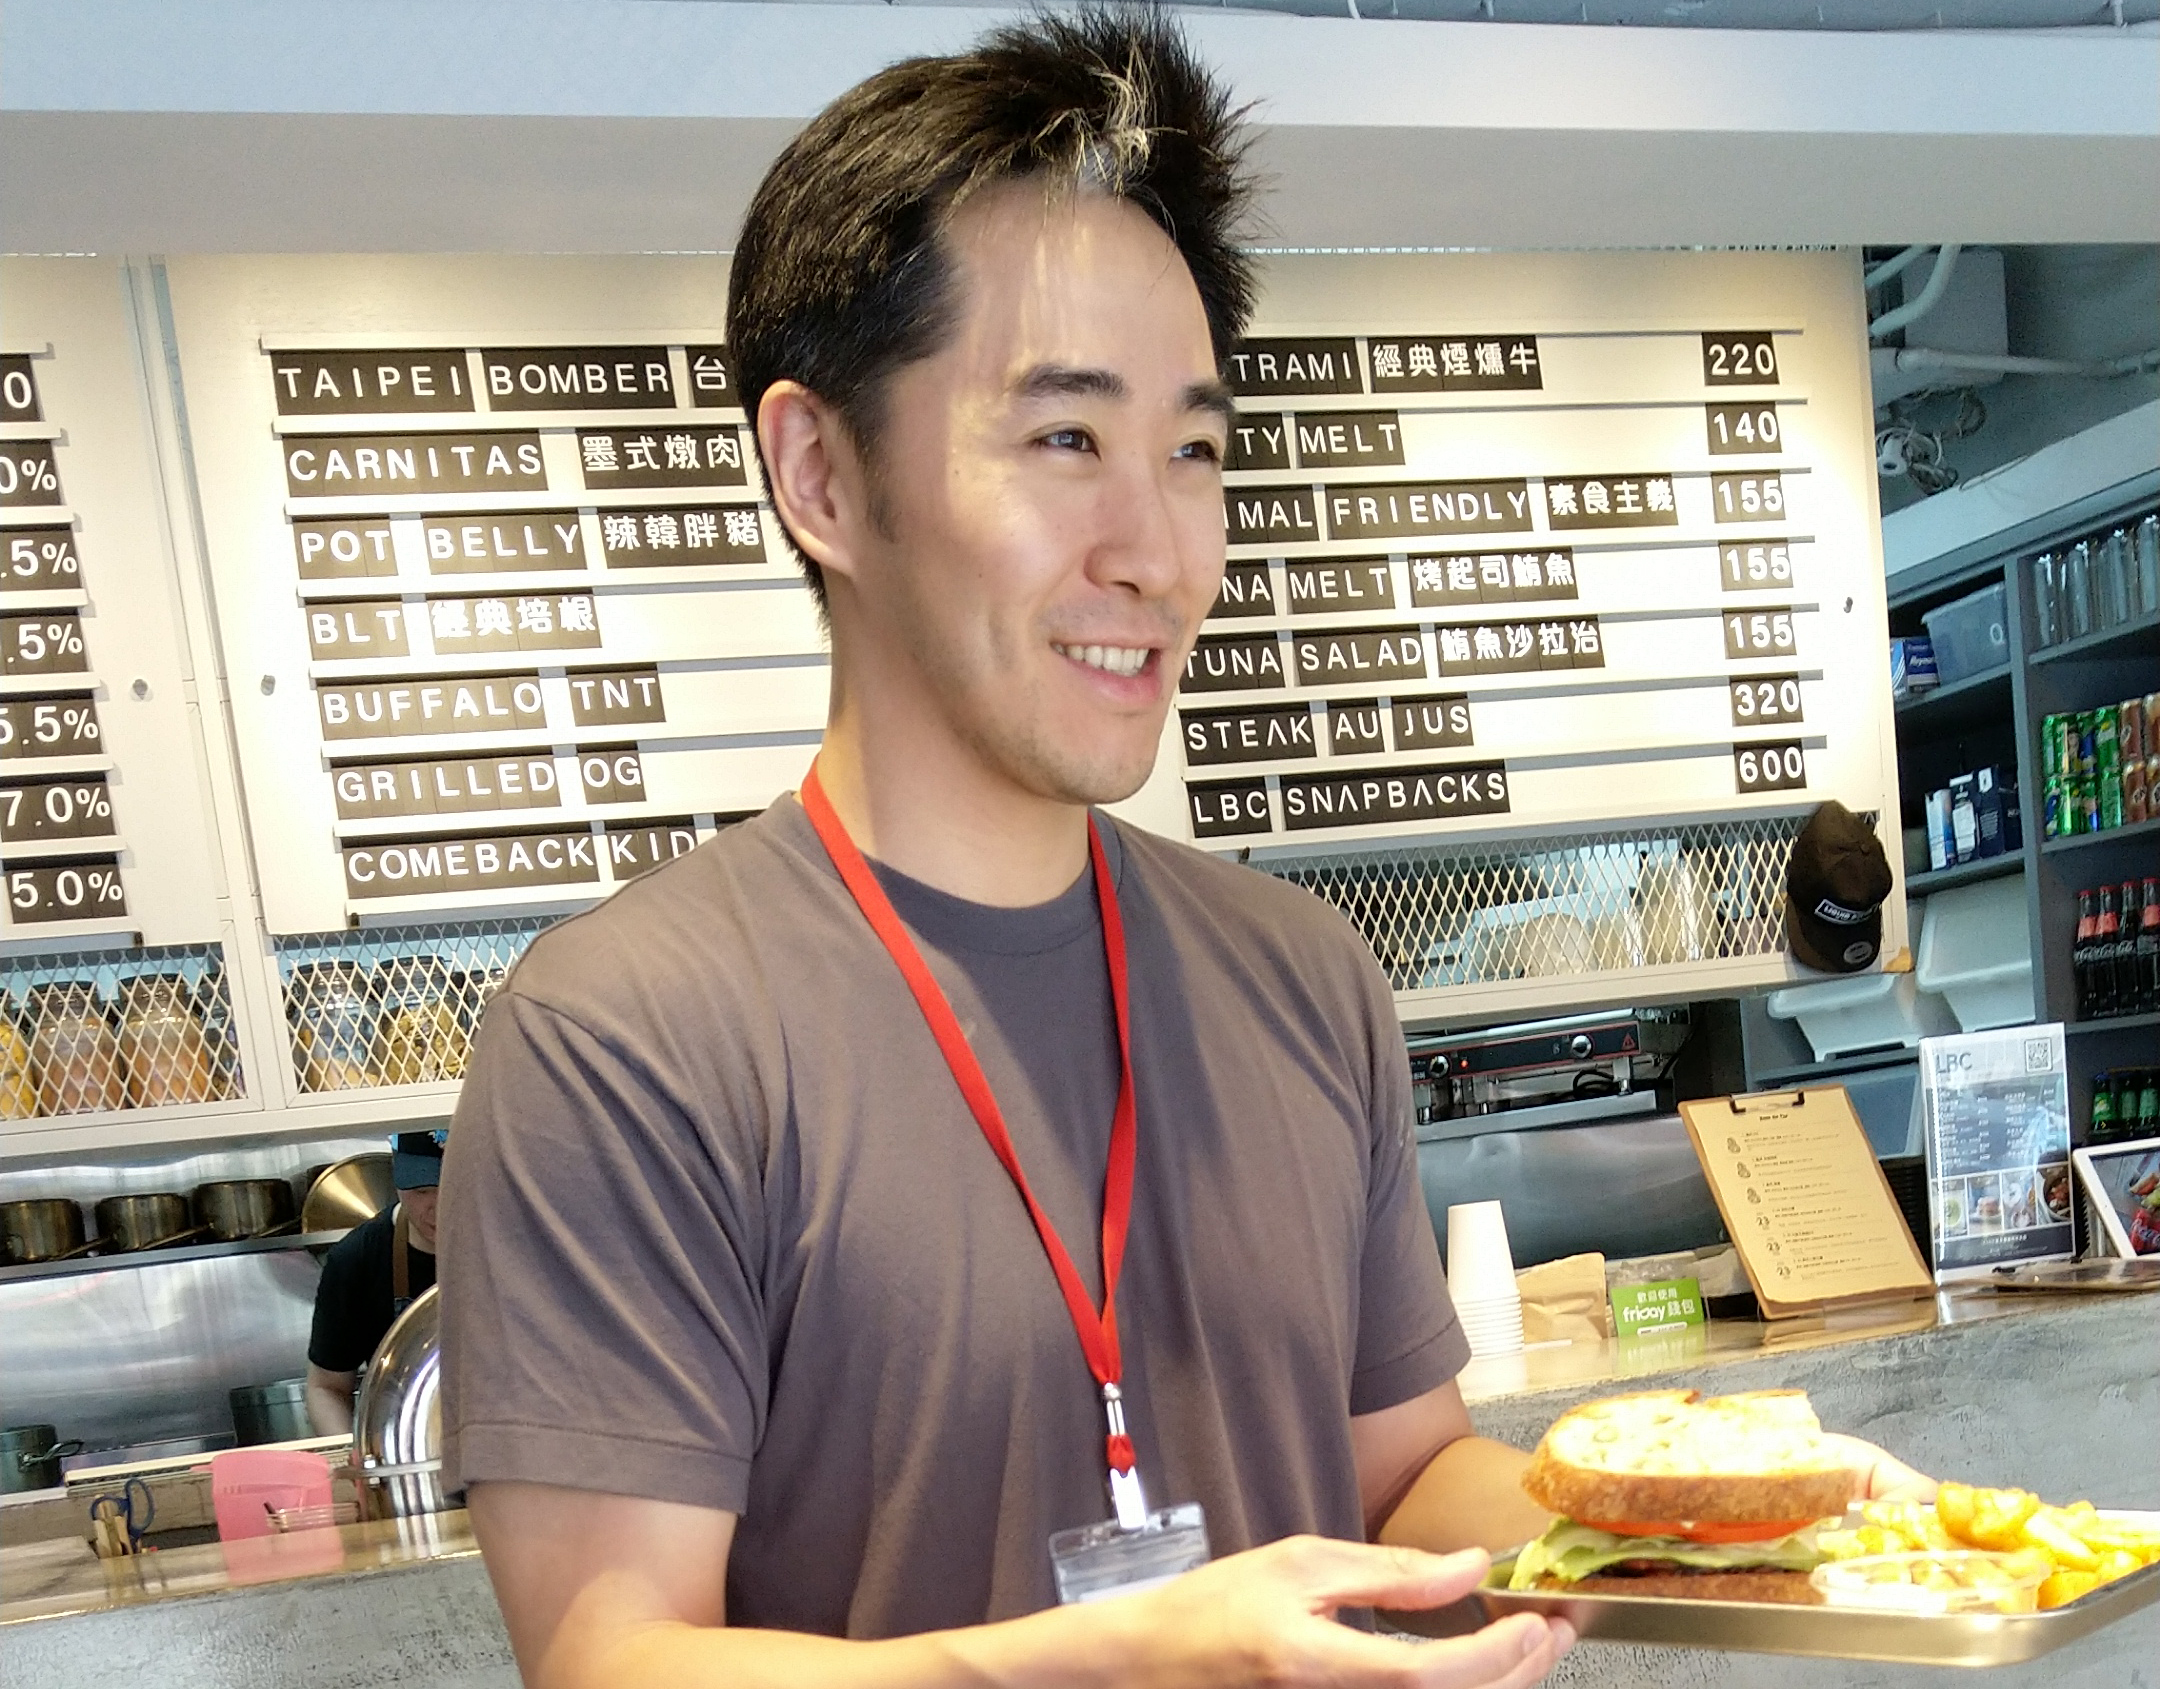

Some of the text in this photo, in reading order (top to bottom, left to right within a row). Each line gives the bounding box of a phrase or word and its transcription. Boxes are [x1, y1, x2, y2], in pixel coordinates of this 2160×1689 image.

[278, 355, 727, 399] TAIPEI BOMBER 台
[1231, 342, 1537, 382] TRAMI 經典煙燻牛
[1708, 343, 1774, 376] 220
[1236, 422, 1399, 456] TY MELT
[1713, 411, 1778, 444] 140
[0, 456, 57, 494] 0%
[290, 433, 741, 482] CARNITAS 墨式燉肉
[1223, 479, 1674, 530] IMAL FRIENDLY 素食主義
[1718, 479, 1783, 512] 155
[300, 511, 760, 563] POT BELLY 辣韓胖豬
[0, 539, 78, 578] .5%
[1222, 552, 1574, 603] NA MELT 烤起司鮪魚
[1726, 547, 1791, 581] 155
[0, 623, 83, 663] .5%
[313, 609, 401, 645] BLT
[1730, 614, 1793, 648] 155
[1186, 620, 1600, 679] TUNA SALAD 鮪魚沙拉治
[322, 676, 657, 725] BUFFALO TNT
[1735, 680, 1799, 716] 320
[1334, 711, 1379, 741] AU
[1403, 705, 1469, 737] JUS
[336, 757, 641, 803] GRILLED OG
[1739, 746, 1802, 783] 600
[0, 787, 111, 827] 7.0%
[1193, 790, 1268, 825] LBC
[348, 830, 695, 883] COMEBACK KID
[11, 870, 123, 908] 5.0%
[1935, 1052, 1973, 1074] LBC
